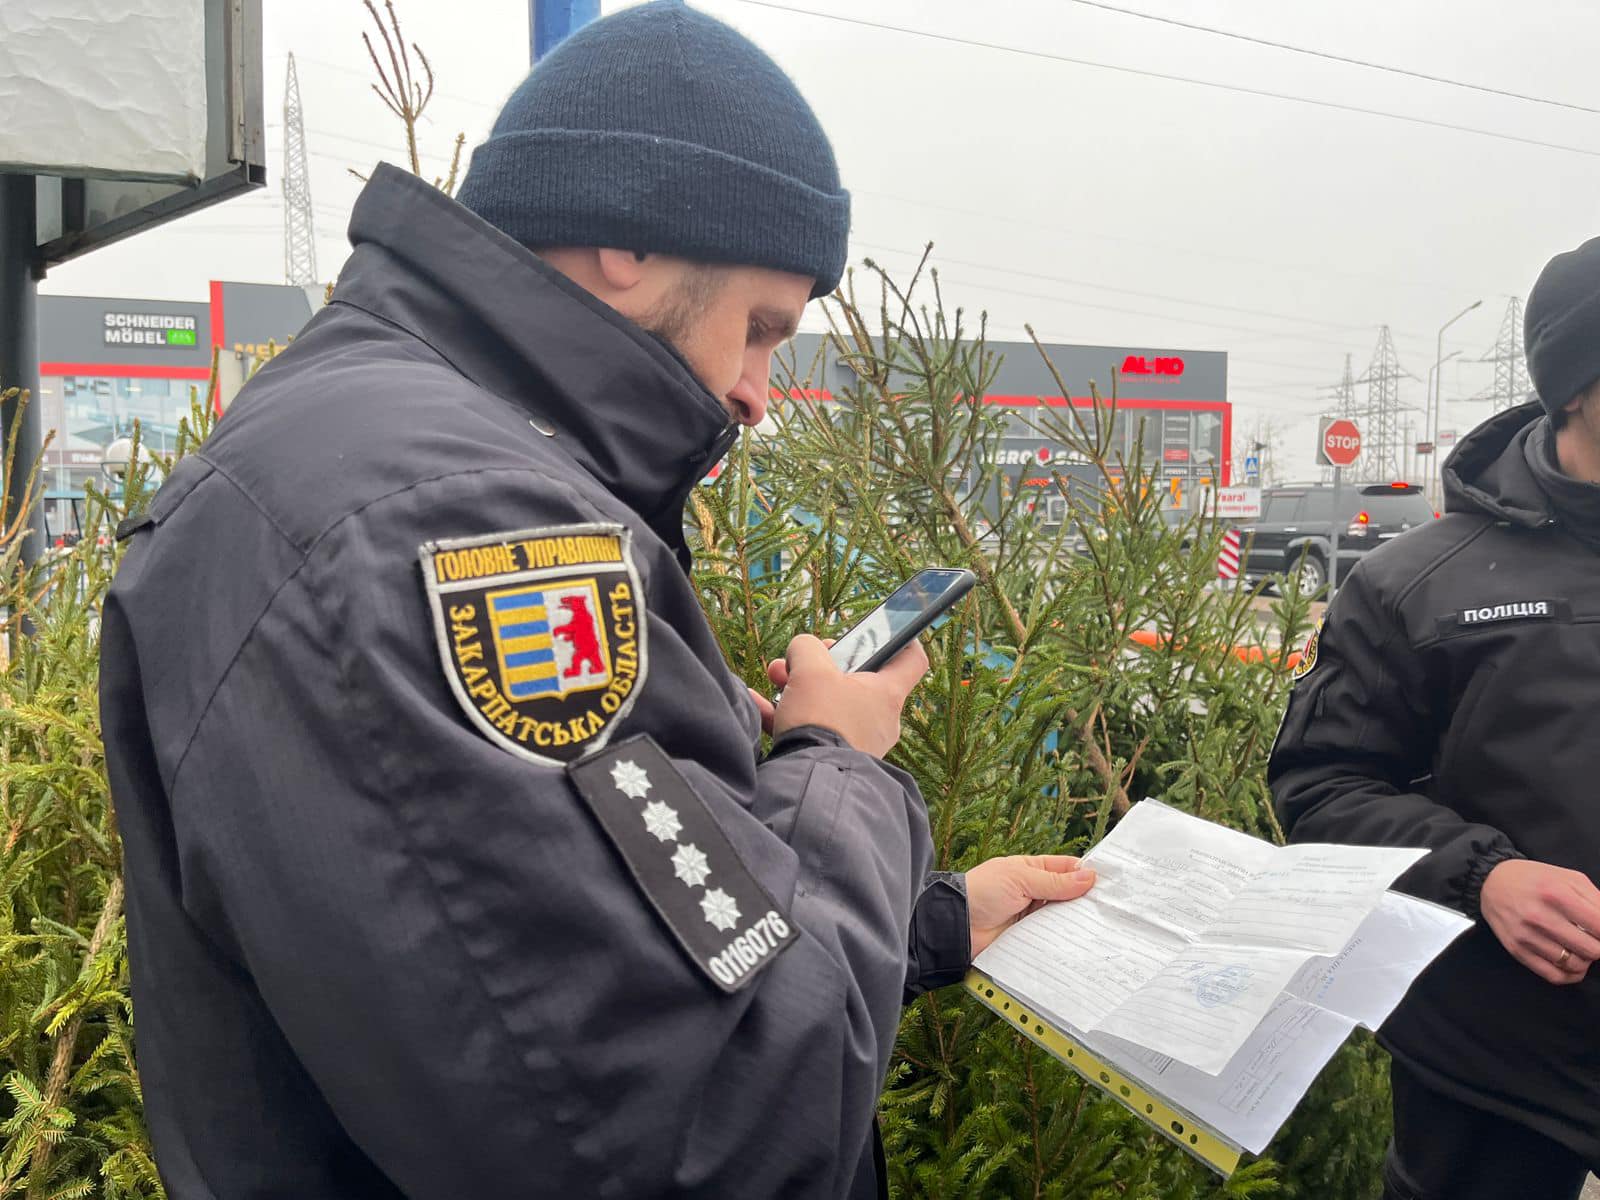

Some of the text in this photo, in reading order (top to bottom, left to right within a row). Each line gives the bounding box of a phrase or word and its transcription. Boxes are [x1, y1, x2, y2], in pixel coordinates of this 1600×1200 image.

[104, 313, 195, 329] SCHNEIDER
[105, 327, 166, 344] MÖBEL
[1327, 433, 1360, 450] STOP
[435, 535, 622, 583] ГОЛОВНЕ УПРАВЛІННЯ
[1463, 602, 1547, 622] ПОЛІЦІЯ
[450, 582, 639, 746] ЗАКАРПАТСЬКА ОБЛАСТЬ
[709, 911, 789, 984] 0116076
